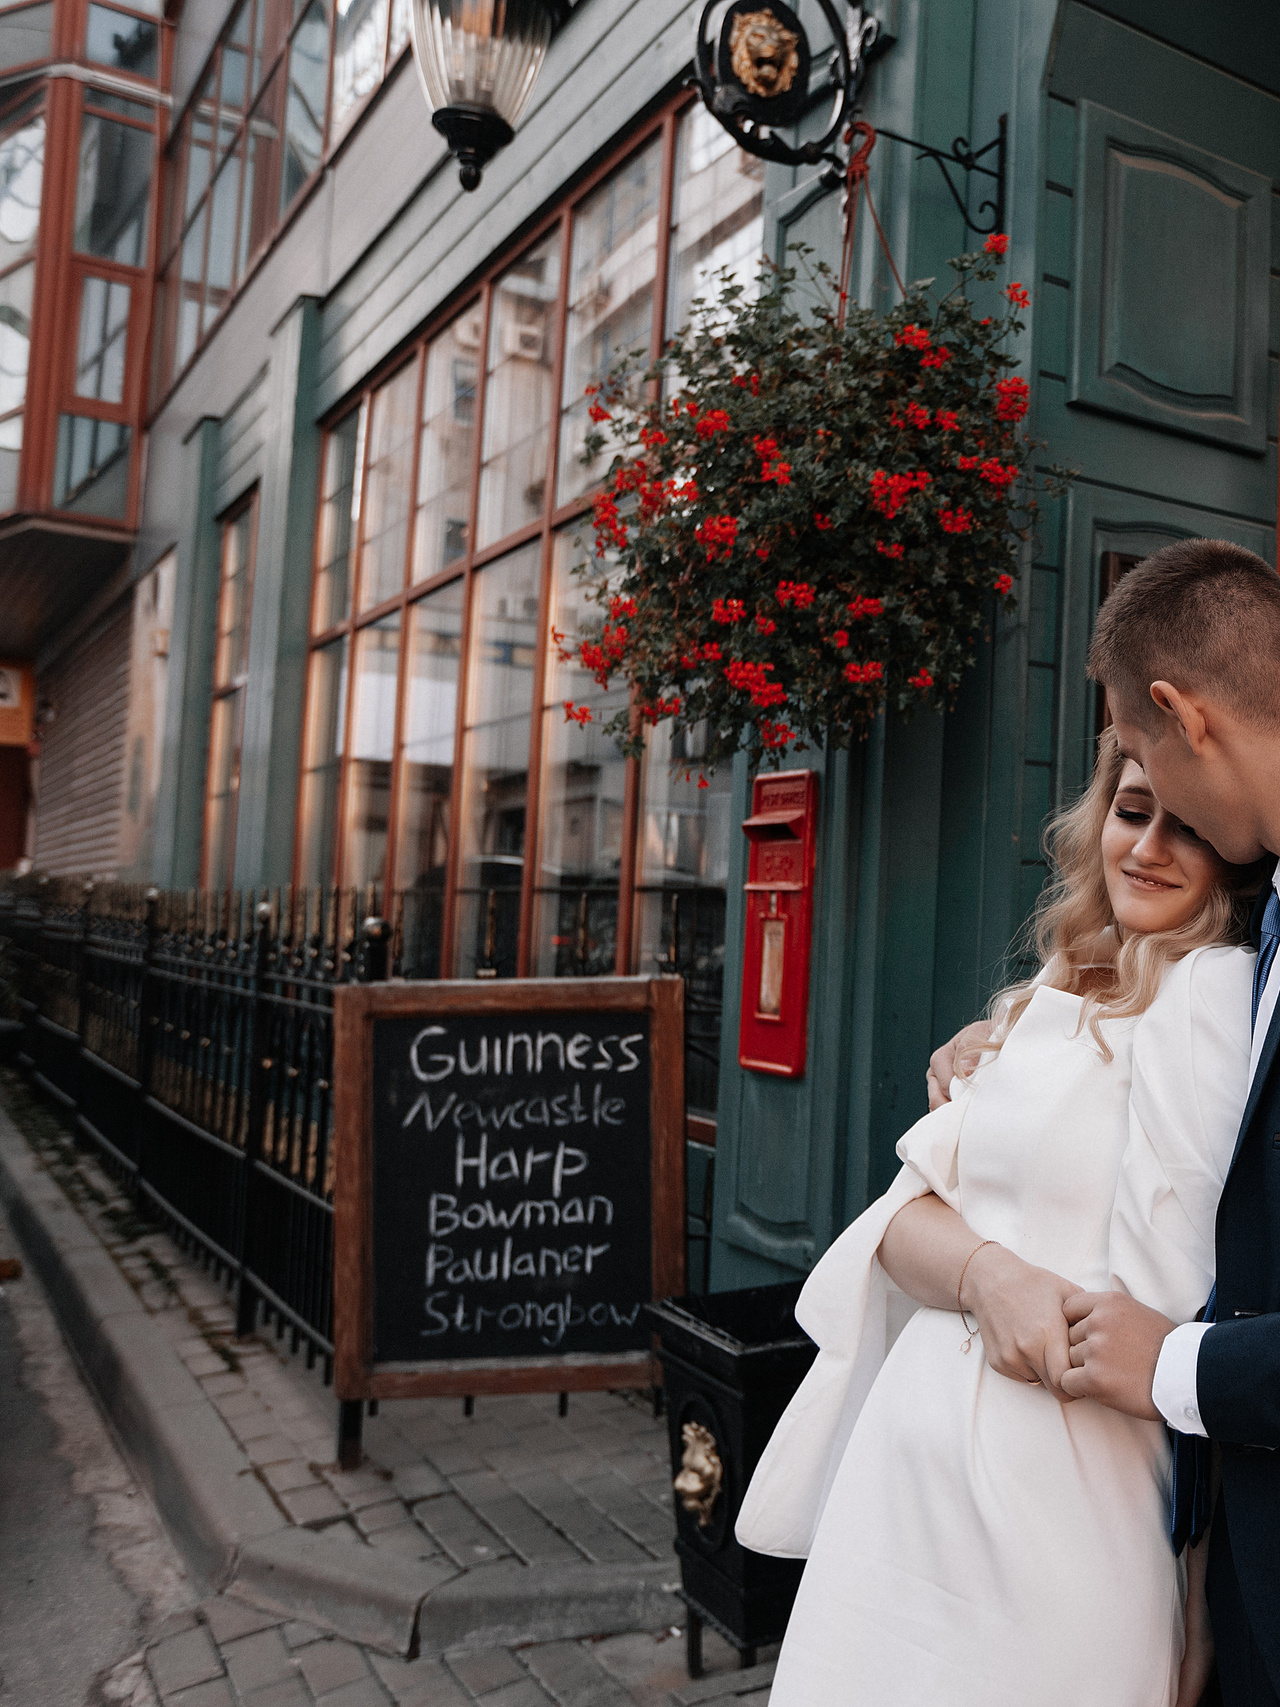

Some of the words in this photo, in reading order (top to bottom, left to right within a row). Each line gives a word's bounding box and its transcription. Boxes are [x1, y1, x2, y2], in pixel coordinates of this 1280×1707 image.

[410, 1025, 644, 1082] Guinness
[402, 1083, 627, 1132] Newcastle
[455, 1133, 588, 1198] Harp
[428, 1193, 613, 1237] Bowman
[425, 1237, 610, 1288] Paulaner
[420, 1291, 640, 1346] Strongbow
